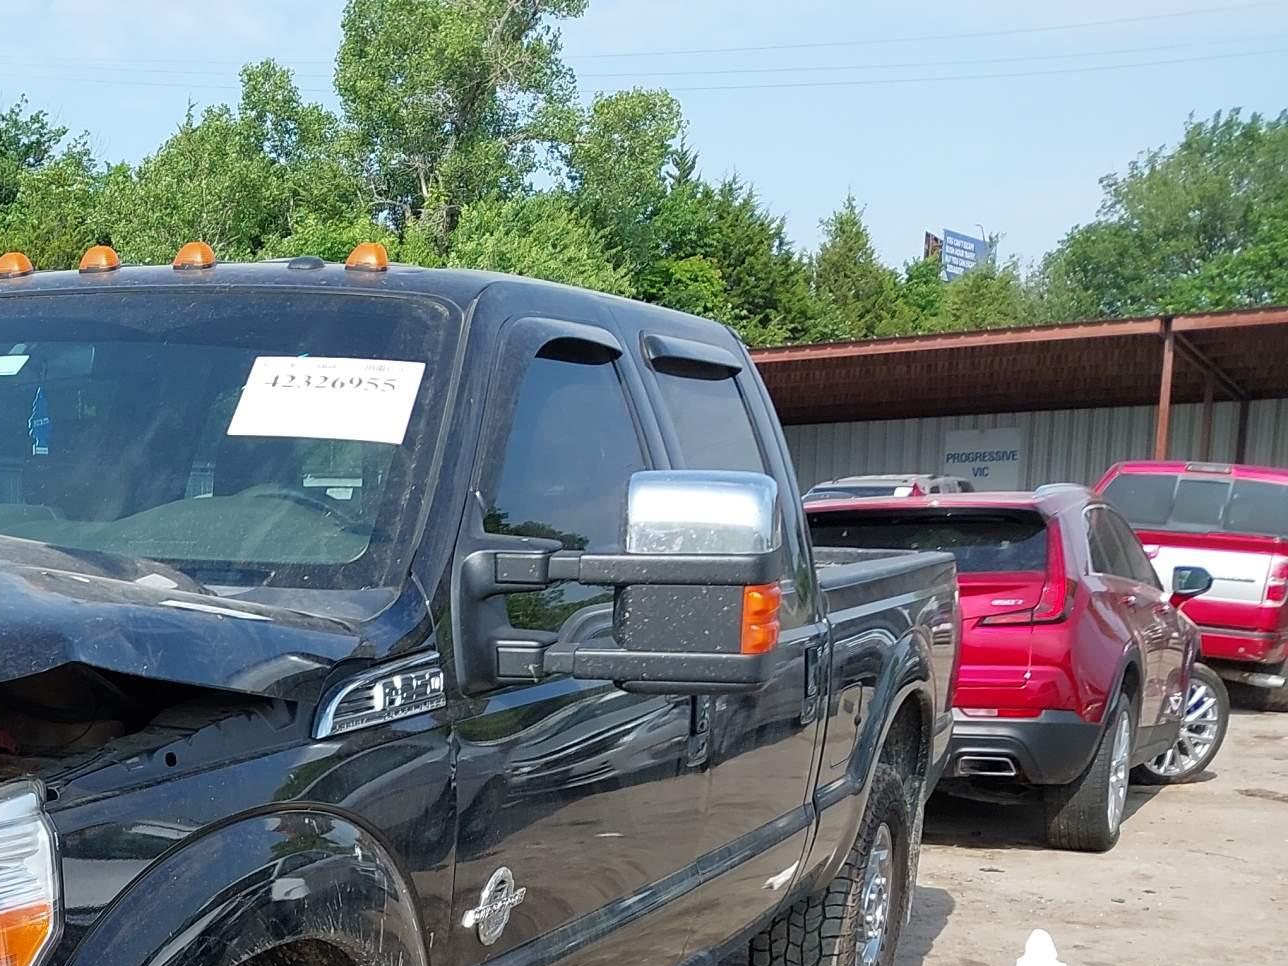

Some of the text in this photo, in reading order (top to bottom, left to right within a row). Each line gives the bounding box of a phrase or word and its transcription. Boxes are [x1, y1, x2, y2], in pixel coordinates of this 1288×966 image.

[263, 374, 400, 392] 42326955
[945, 450, 1018, 463] PROGRESSIVE
[972, 466, 989, 477] VIC
